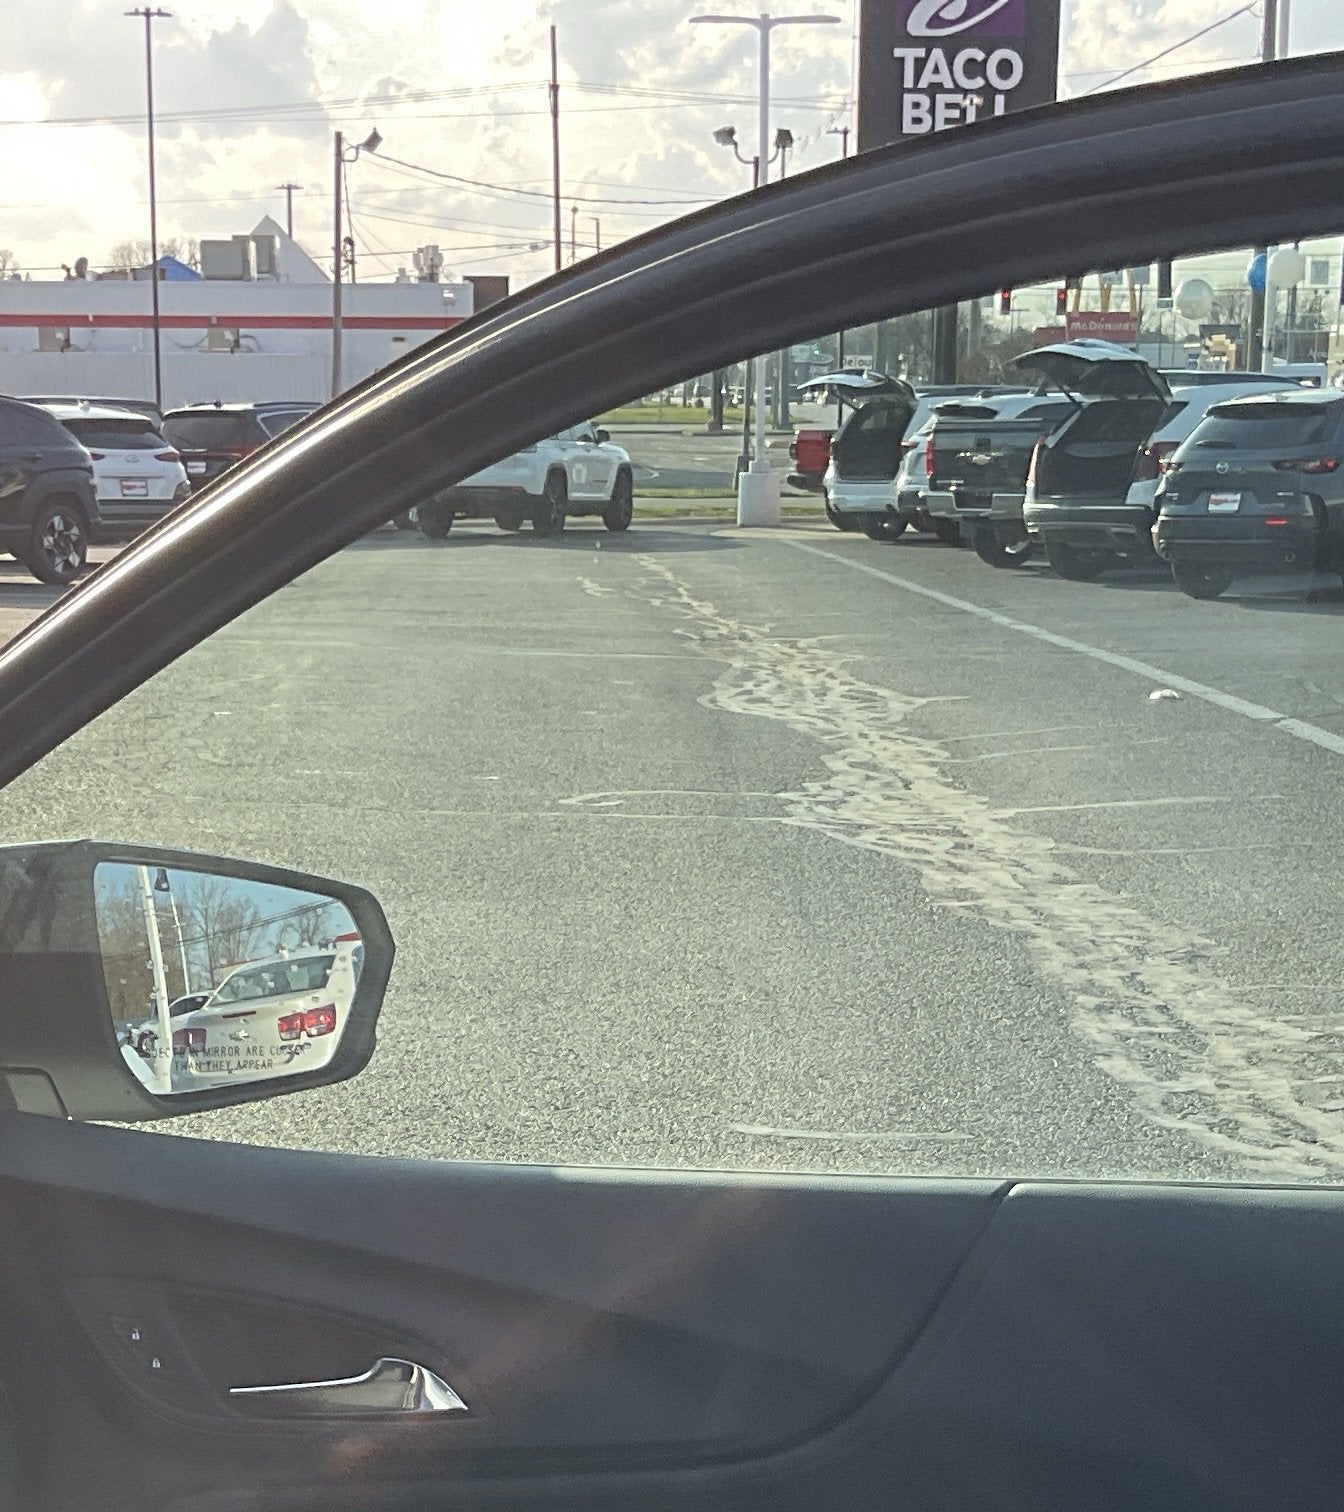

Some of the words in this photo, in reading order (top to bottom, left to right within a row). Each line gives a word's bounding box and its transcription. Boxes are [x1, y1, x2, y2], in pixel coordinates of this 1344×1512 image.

[893, 47, 1024, 91] TACO
[205, 1045, 243, 1057] MIRROR
[246, 1045, 265, 1057] ARE
[175, 1060, 202, 1071] THAN
[207, 1060, 231, 1071] THEY
[236, 1059, 273, 1071] APPEAR
